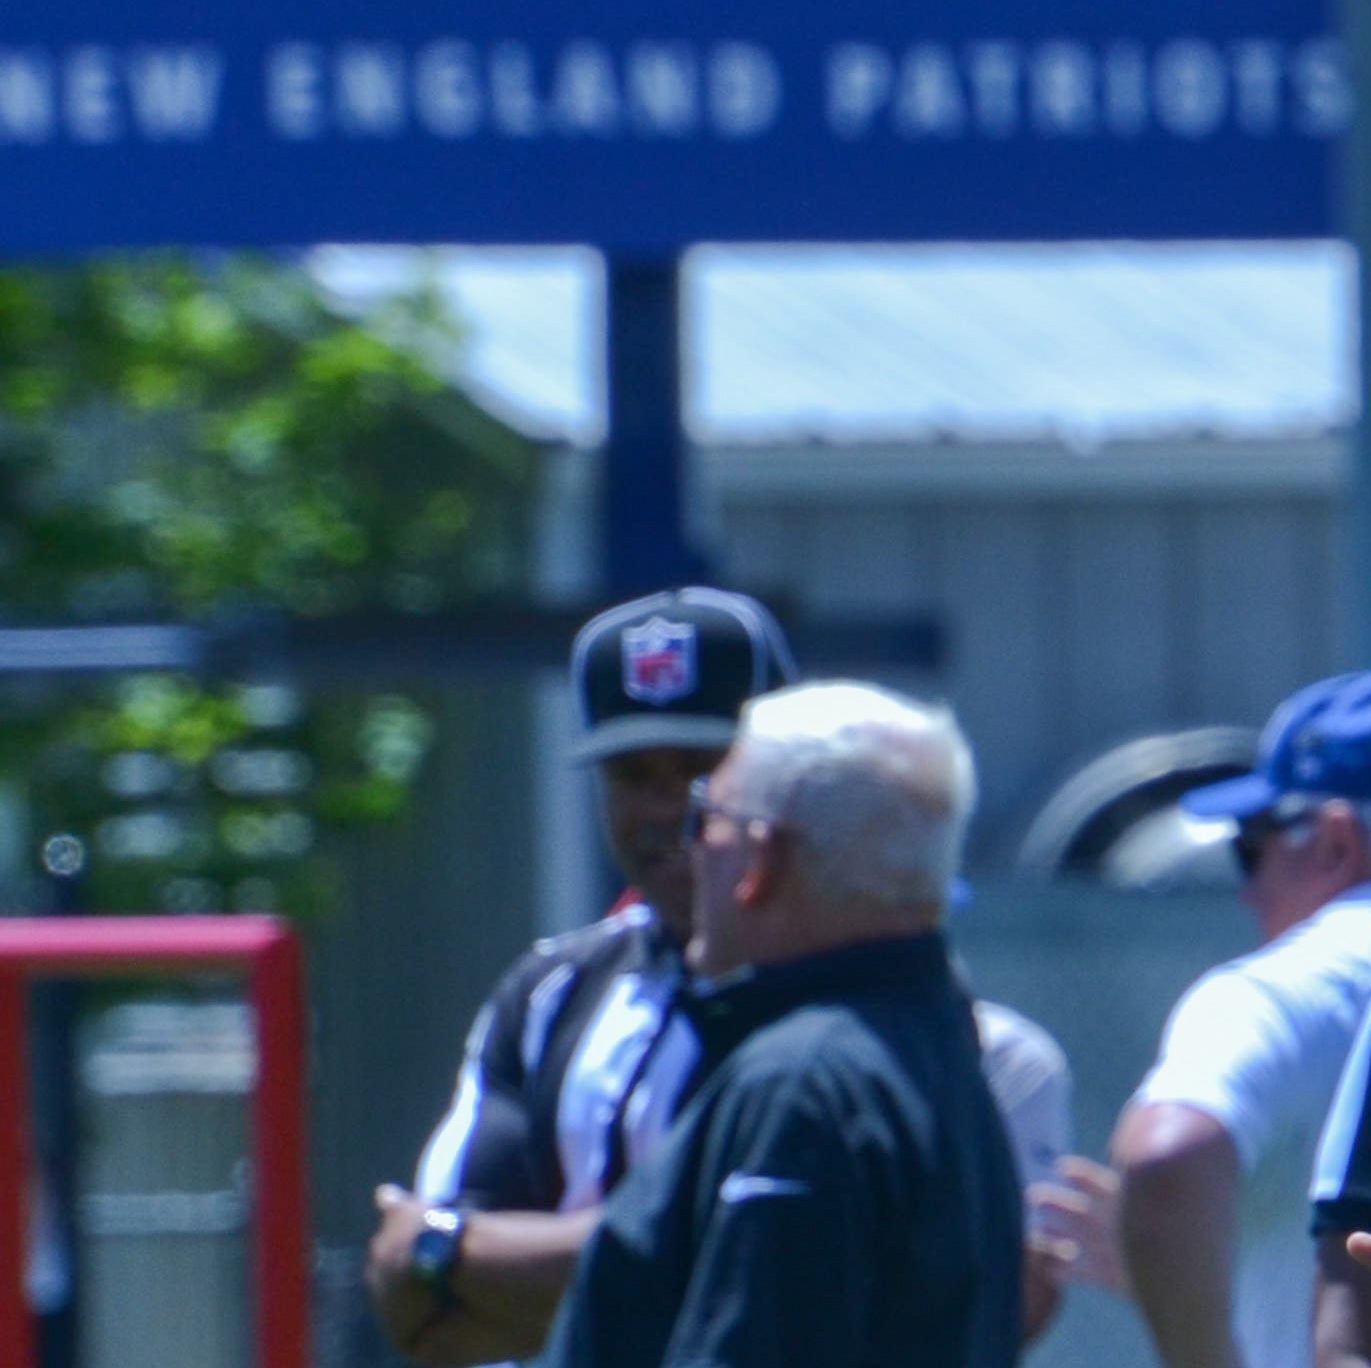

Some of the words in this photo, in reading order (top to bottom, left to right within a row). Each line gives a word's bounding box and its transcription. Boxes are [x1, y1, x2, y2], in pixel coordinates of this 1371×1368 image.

[0, 46, 222, 142] NEW
[265, 40, 782, 140] ENGLAND
[824, 39, 1352, 140] PATRIOTS
